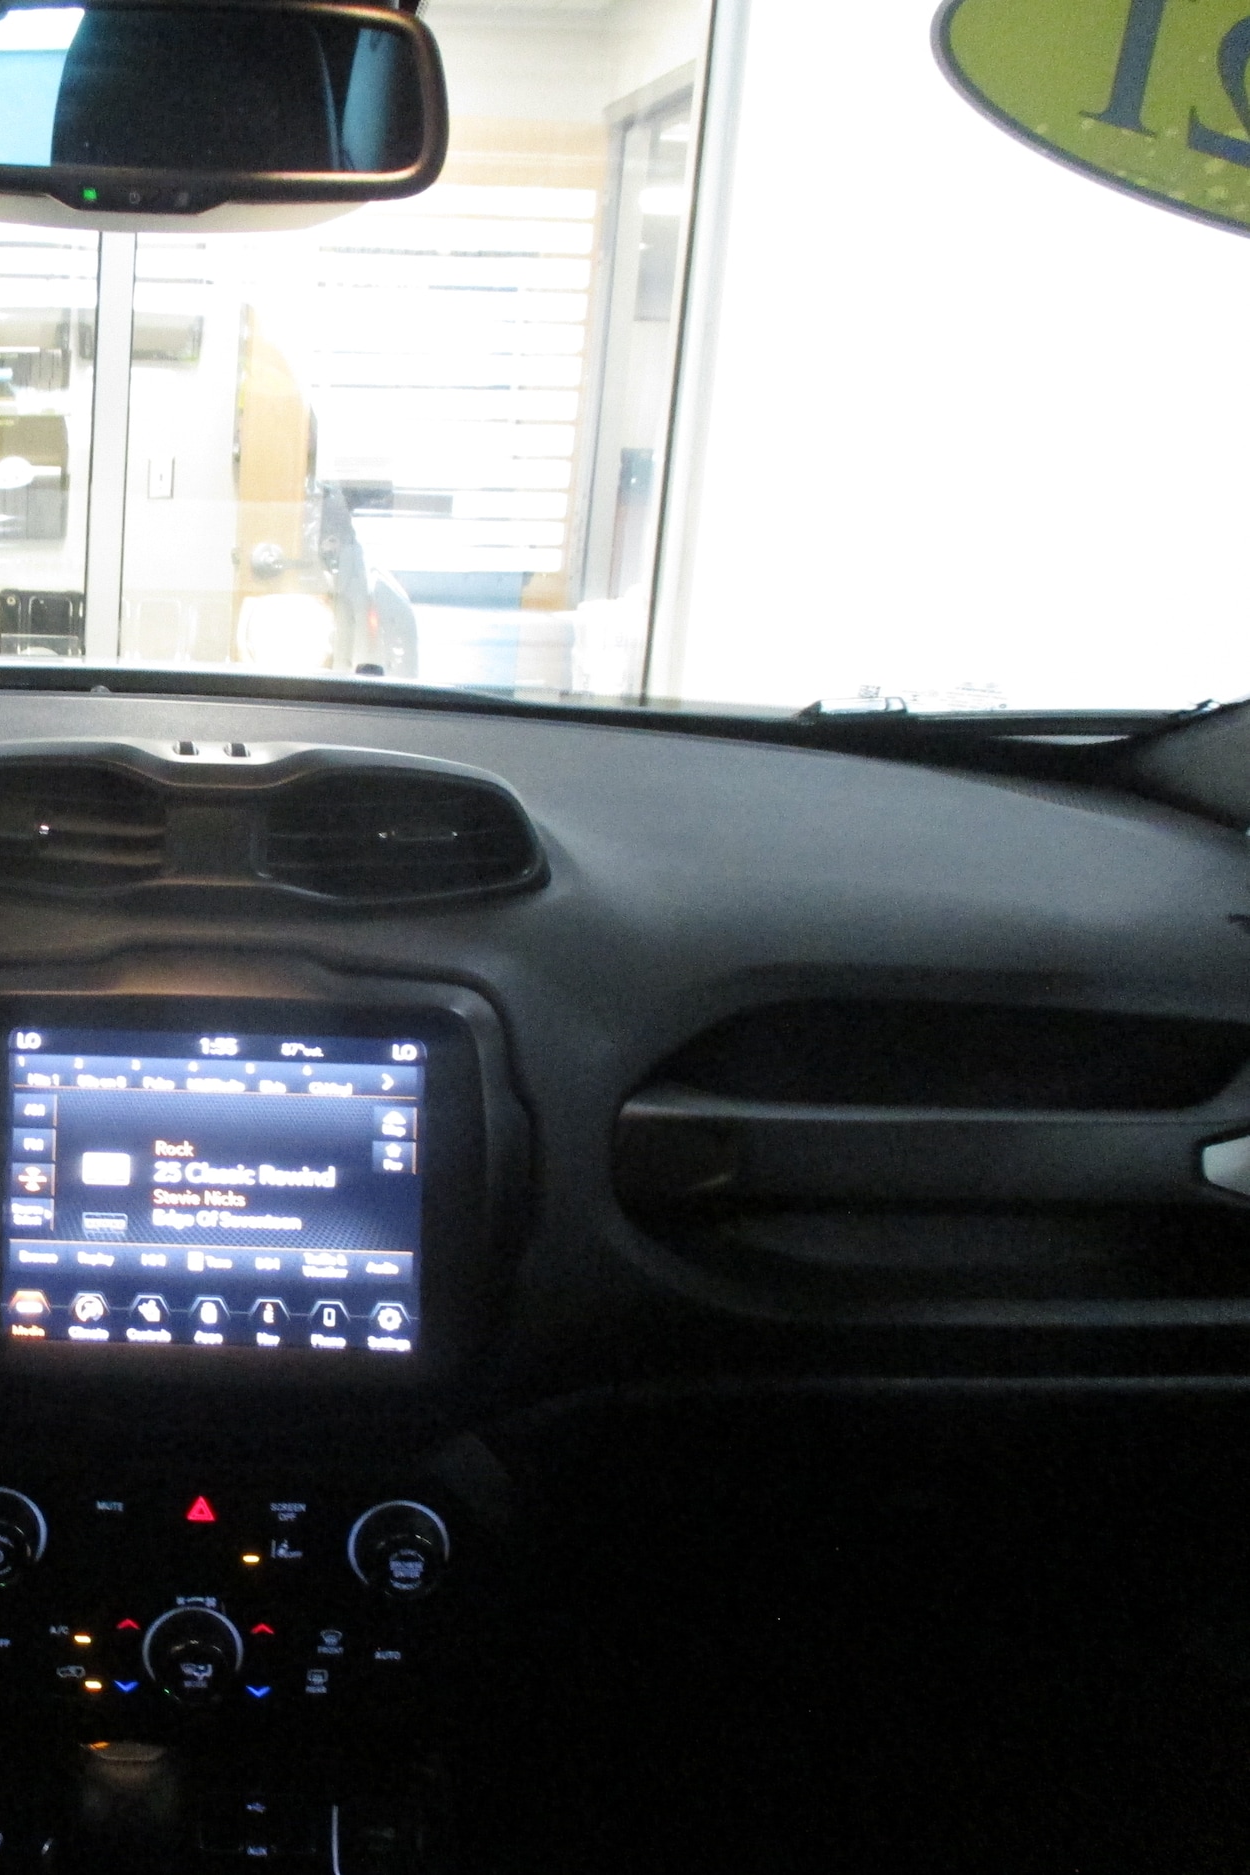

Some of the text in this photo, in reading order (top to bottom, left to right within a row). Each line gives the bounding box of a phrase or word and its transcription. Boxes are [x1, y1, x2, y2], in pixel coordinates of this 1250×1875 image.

[16, 1031, 42, 1050] LO
[391, 1043, 418, 1061] LO
[154, 1139, 195, 1157] Rock
[152, 1160, 337, 1188] 25 Classic Rewind
[152, 1188, 247, 1208] Stevie Nicks
[152, 1208, 195, 1230] Edge
[195, 1210, 220, 1228] Of
[218, 1210, 303, 1231] Seventeen
[11, 1323, 46, 1338] Media
[96, 1500, 125, 1512] MUTE
[269, 1502, 307, 1513] SCREEN
[278, 1512, 296, 1522] OFF
[374, 1650, 402, 1660] AUTO
